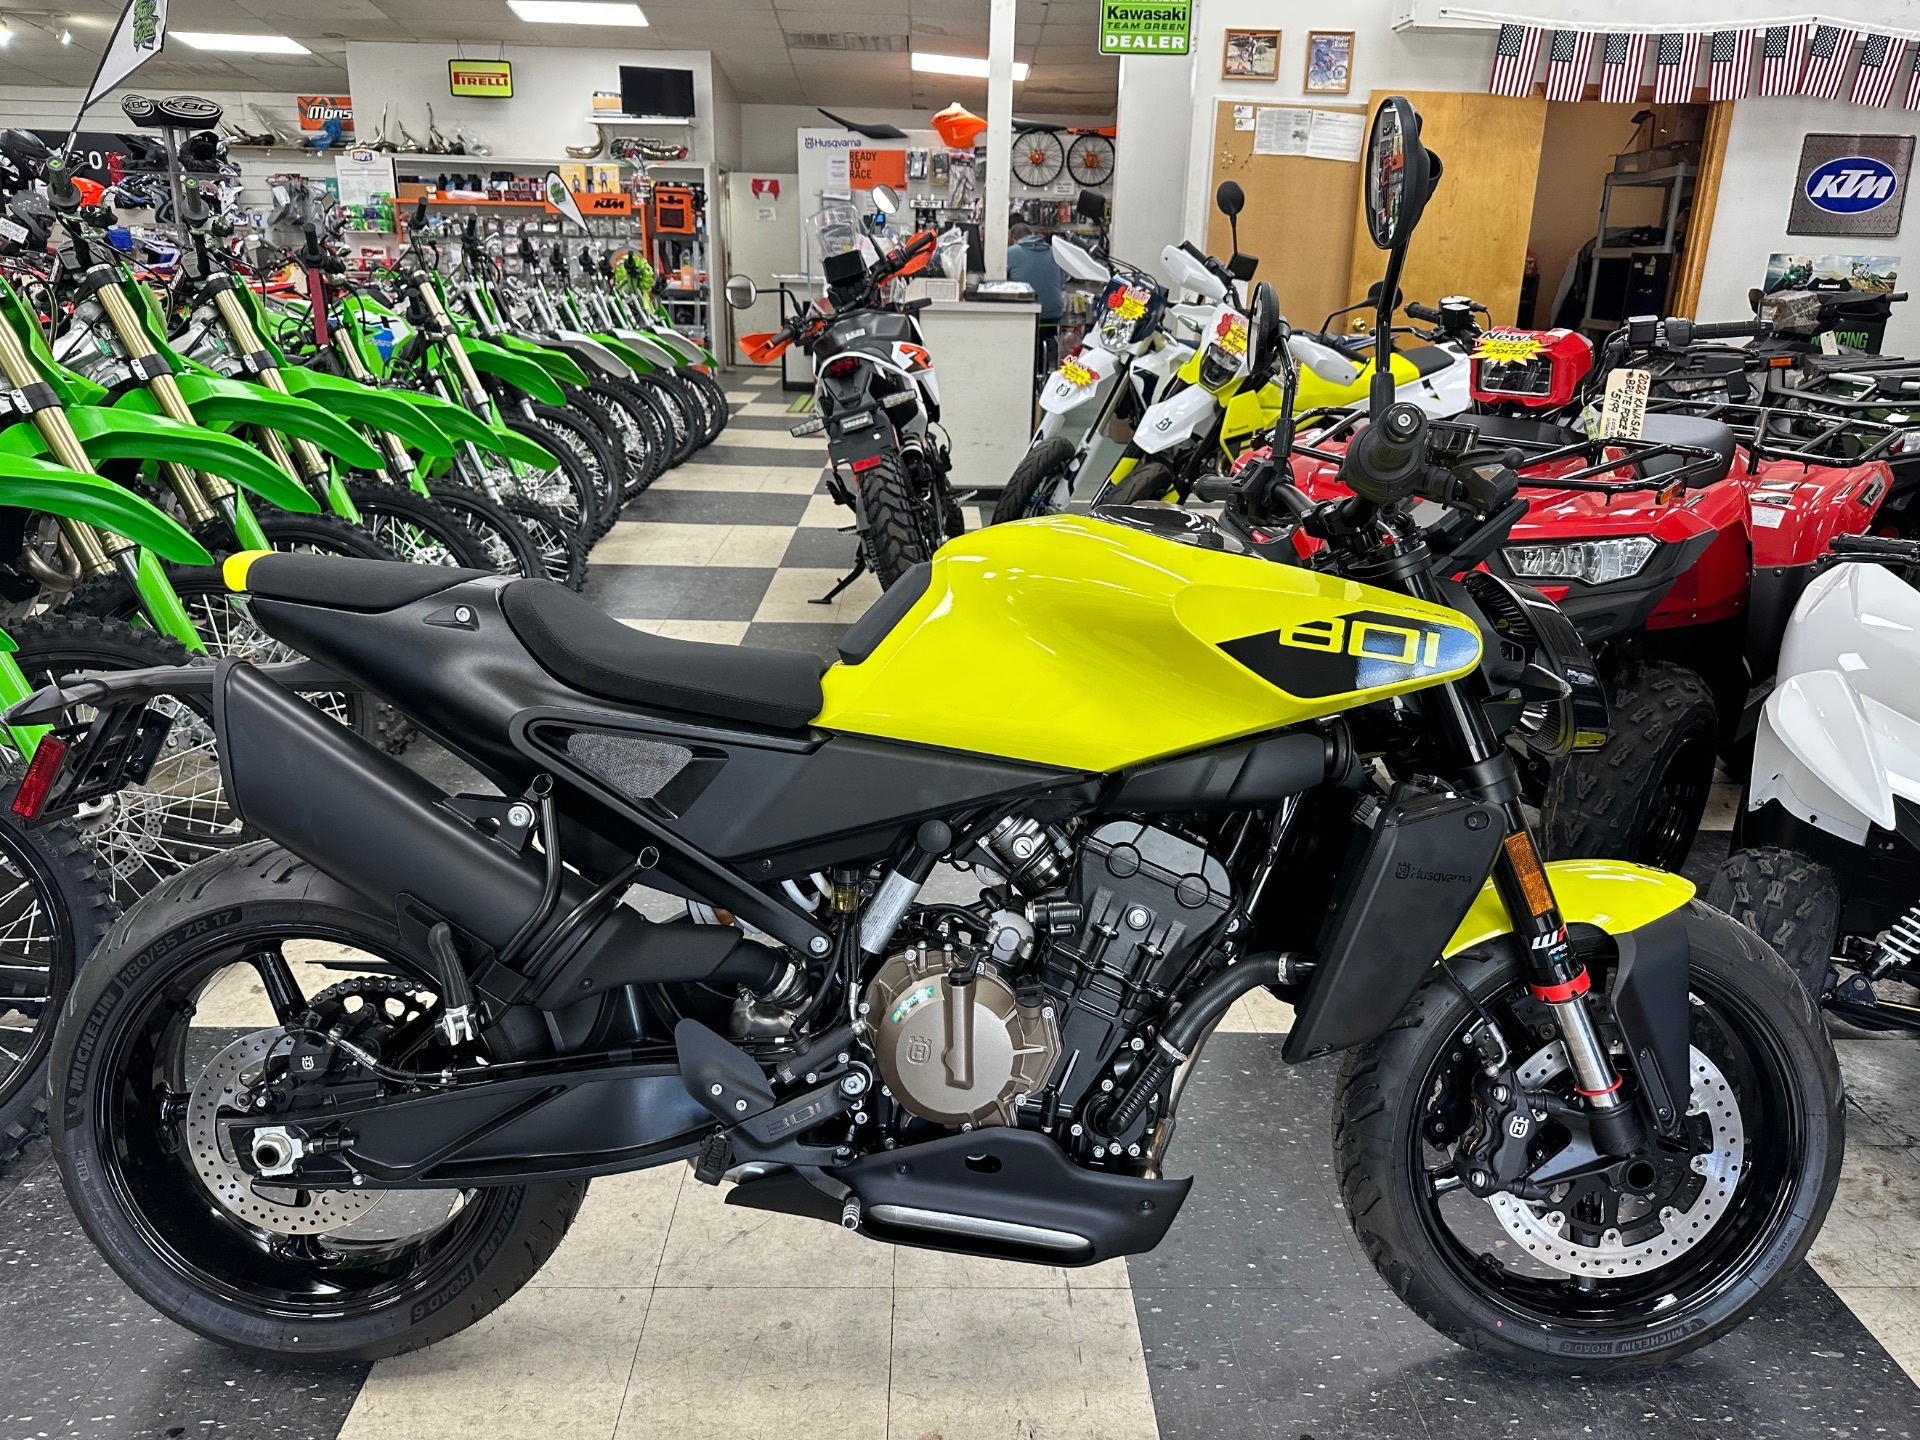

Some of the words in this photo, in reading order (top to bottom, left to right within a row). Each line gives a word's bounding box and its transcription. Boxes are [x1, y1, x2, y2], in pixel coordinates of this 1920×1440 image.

[1107, 6, 1187, 21] Kawasaki
[1107, 22, 1140, 30] TEAM
[1144, 23, 1186, 31] GREEN
[1105, 35, 1186, 49] DEALER
[453, 71, 509, 87] PIRELLI
[164, 100, 216, 112] KBC
[814, 138, 862, 149] Husqvarna
[849, 151, 877, 162] READY
[849, 161, 861, 170] TO
[849, 170, 872, 179] RACE
[1809, 169, 1894, 199] KTM
[593, 197, 625, 209] KTM
[1482, 330, 1533, 342] New!
[1485, 349, 1532, 357] UPDATES!
[1635, 373, 1650, 396] 2026
[1622, 379, 1636, 407] BRUTE
[1278, 617, 1441, 669] 801
[1410, 867, 1473, 884] Husqvarna
[119, 935, 179, 984] 180/55
[181, 919, 210, 939] ZR
[211, 910, 234, 927] 17
[1547, 942, 1568, 956] APEX
[69, 990, 119, 1092] MICHELIN
[428, 1268, 472, 1311] ROAD
[414, 1306, 426, 1320] 6
[1620, 1326, 1685, 1352] MICHELIN
[1563, 1342, 1572, 1352] 6
[1574, 1342, 1610, 1354] ROAD
